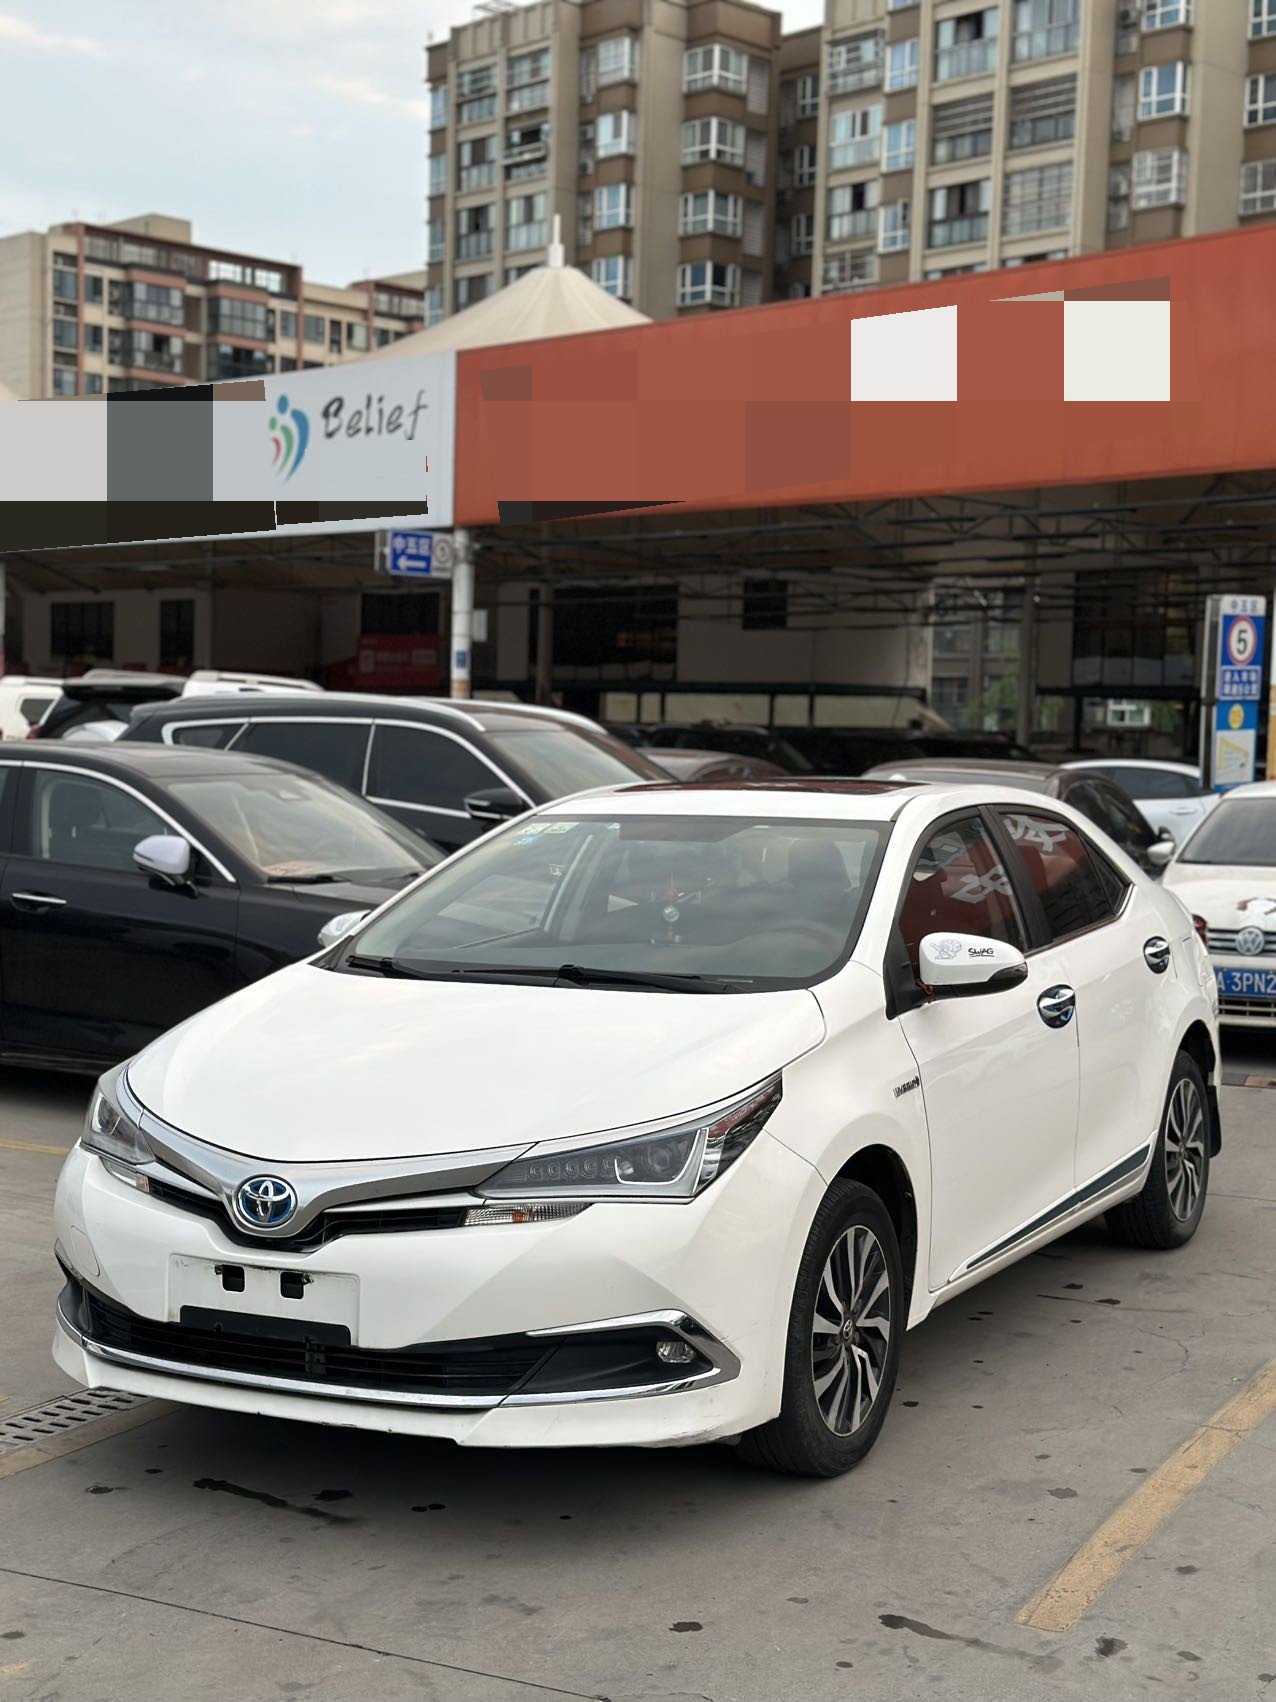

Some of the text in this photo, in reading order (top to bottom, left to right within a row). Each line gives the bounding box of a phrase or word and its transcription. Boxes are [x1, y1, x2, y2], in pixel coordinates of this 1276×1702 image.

[322, 388, 429, 441] Belief
[1236, 629, 1248, 655] 5
[968, 947, 995, 957] SWAG
